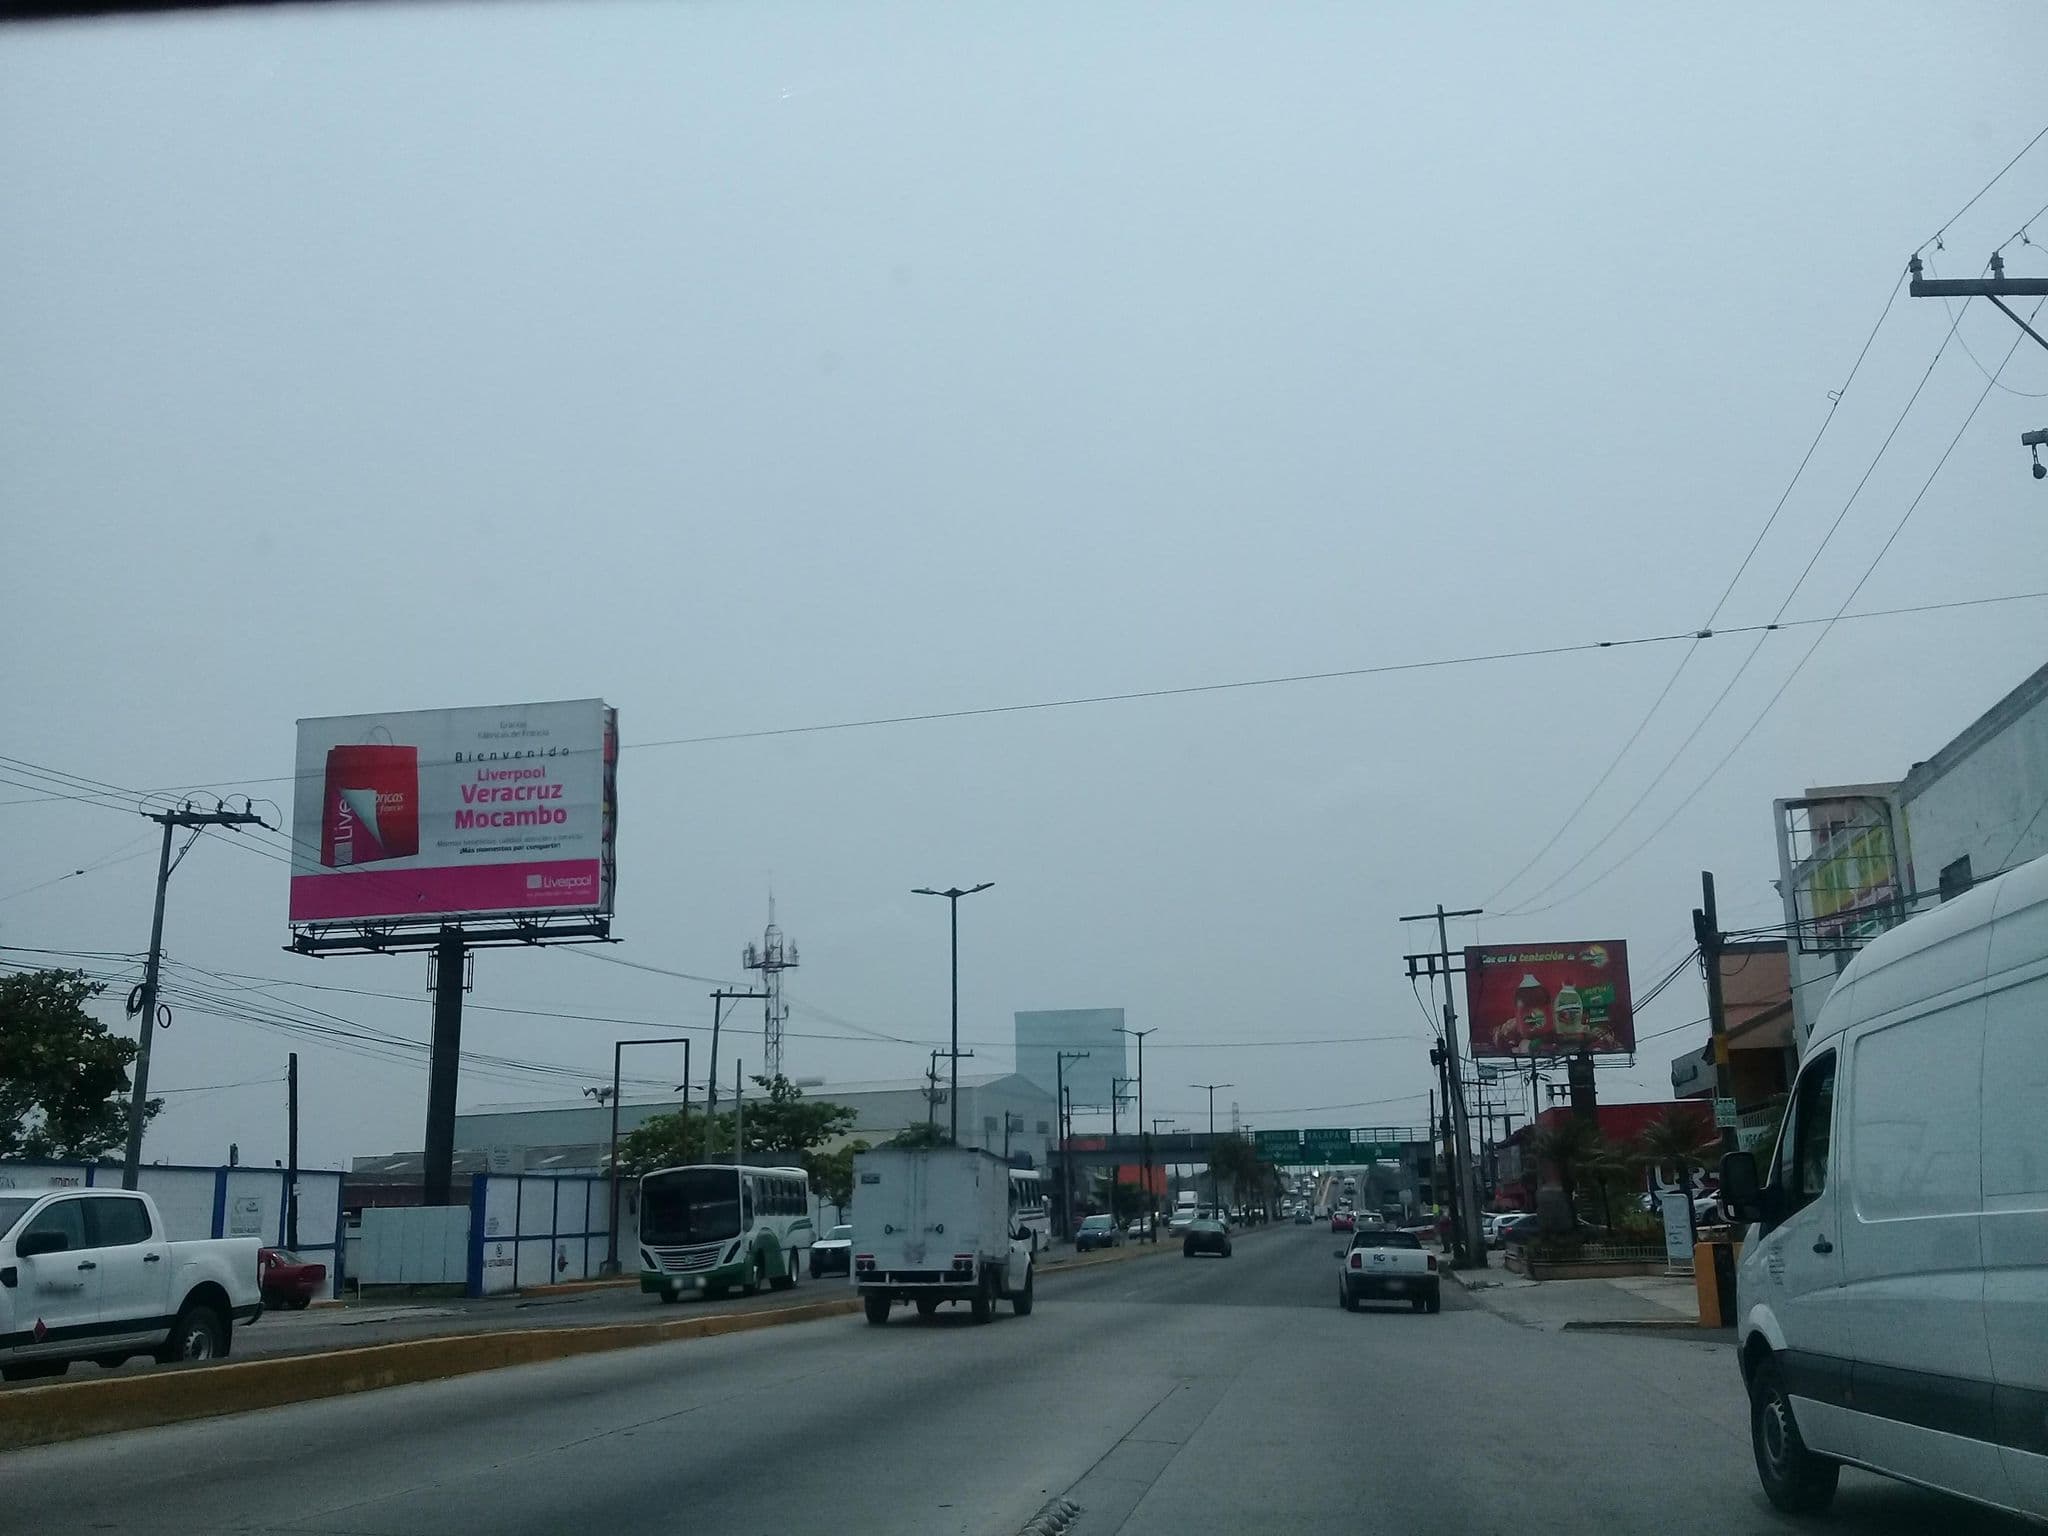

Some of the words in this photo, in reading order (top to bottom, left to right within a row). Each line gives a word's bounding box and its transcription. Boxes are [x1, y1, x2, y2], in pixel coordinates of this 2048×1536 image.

[454, 745, 570, 763] Bienvenido
[477, 765, 546, 782] Liverpool
[460, 783, 563, 804] Veracruz
[455, 805, 568, 829] Mocambo
[544, 874, 592, 889] Liverpool
[1519, 951, 1564, 963] tentación
